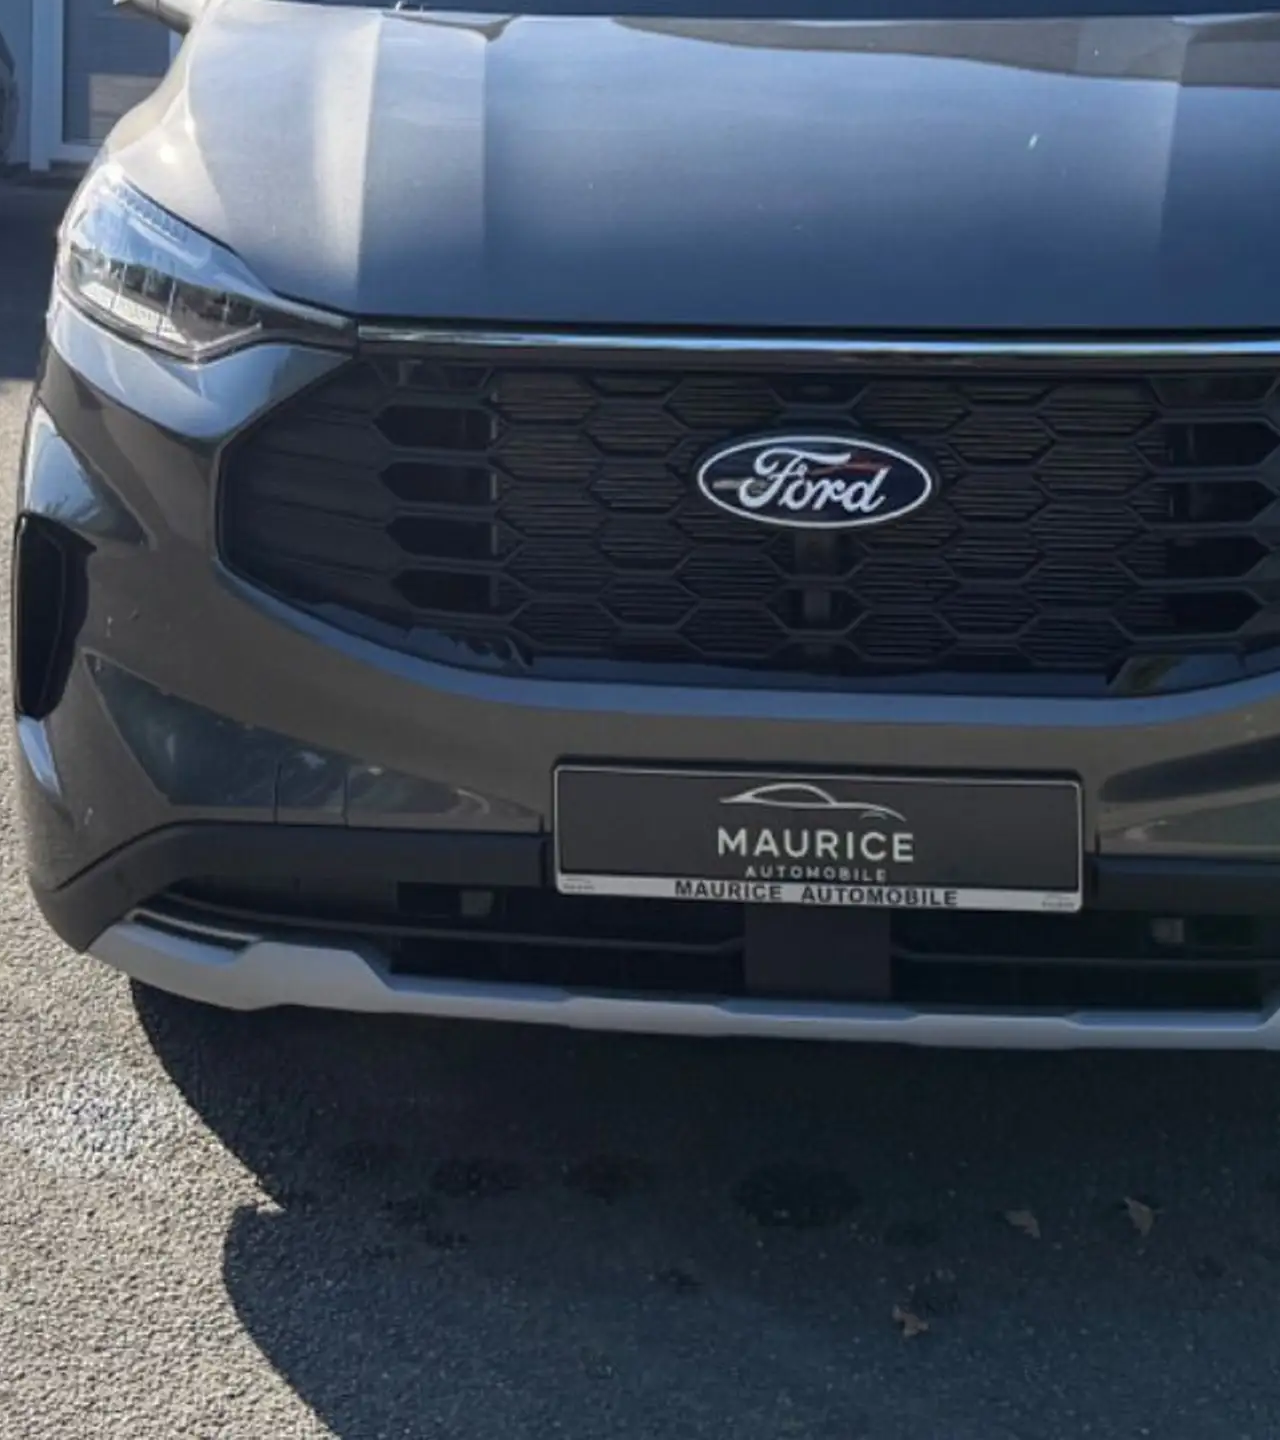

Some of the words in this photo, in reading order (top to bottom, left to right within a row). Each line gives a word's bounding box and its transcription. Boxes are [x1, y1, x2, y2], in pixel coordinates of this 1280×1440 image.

[738, 447, 892, 513] Ford
[717, 826, 915, 862] MAURICE
[745, 865, 887, 882] AUTOMOBILE
[674, 879, 783, 902] MAURICE
[800, 885, 958, 907] AUTOMOBILE
